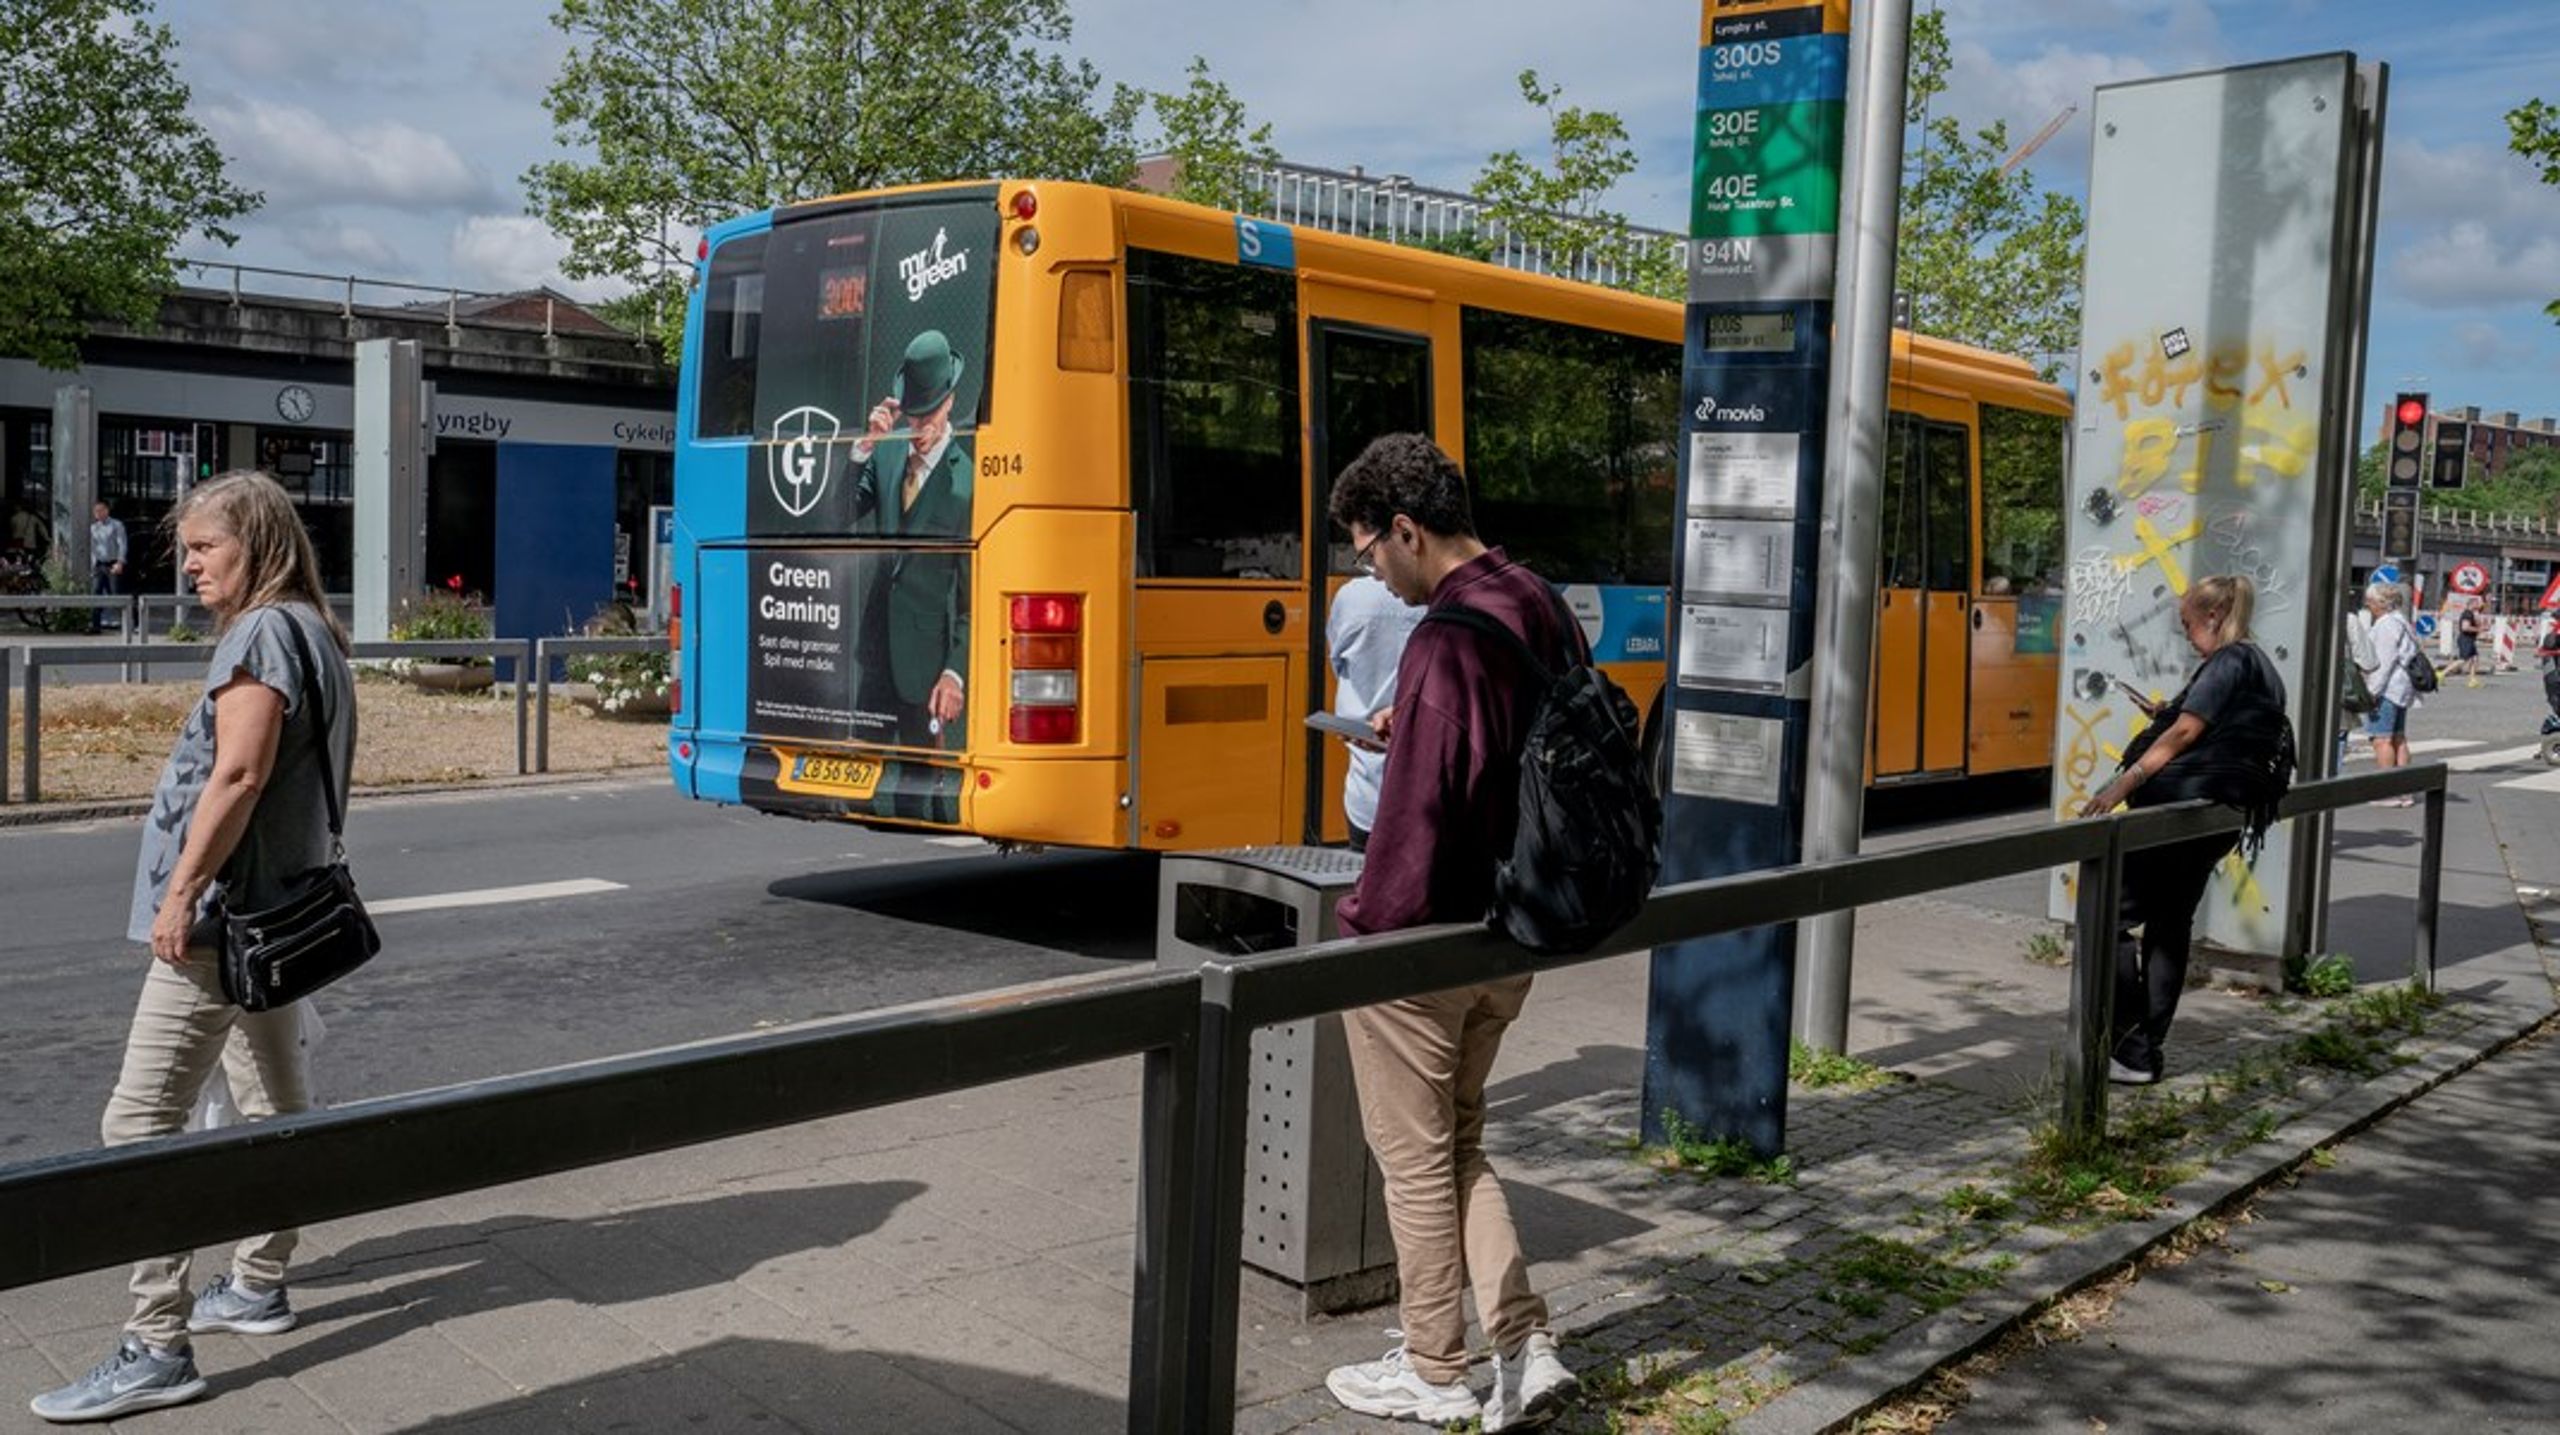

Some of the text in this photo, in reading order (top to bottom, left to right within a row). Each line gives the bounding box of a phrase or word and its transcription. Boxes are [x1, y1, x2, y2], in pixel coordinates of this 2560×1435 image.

[1714, 41, 1781, 70] 300S
[1710, 109, 1759, 135] 30E
[1708, 174, 1758, 199] 40E
[1240, 221, 1262, 257] S
[1702, 239, 1752, 264] 94N
[907, 252, 967, 302] green
[436, 411, 512, 437] yngby
[1716, 404, 1765, 421] movia
[614, 421, 675, 444] Cykelp
[782, 435, 817, 485] G
[981, 454, 1023, 477] 6014
[769, 562, 831, 589] Green
[760, 595, 841, 630] Gaming
[764, 652, 781, 668] Spil
[782, 655, 805, 669] med
